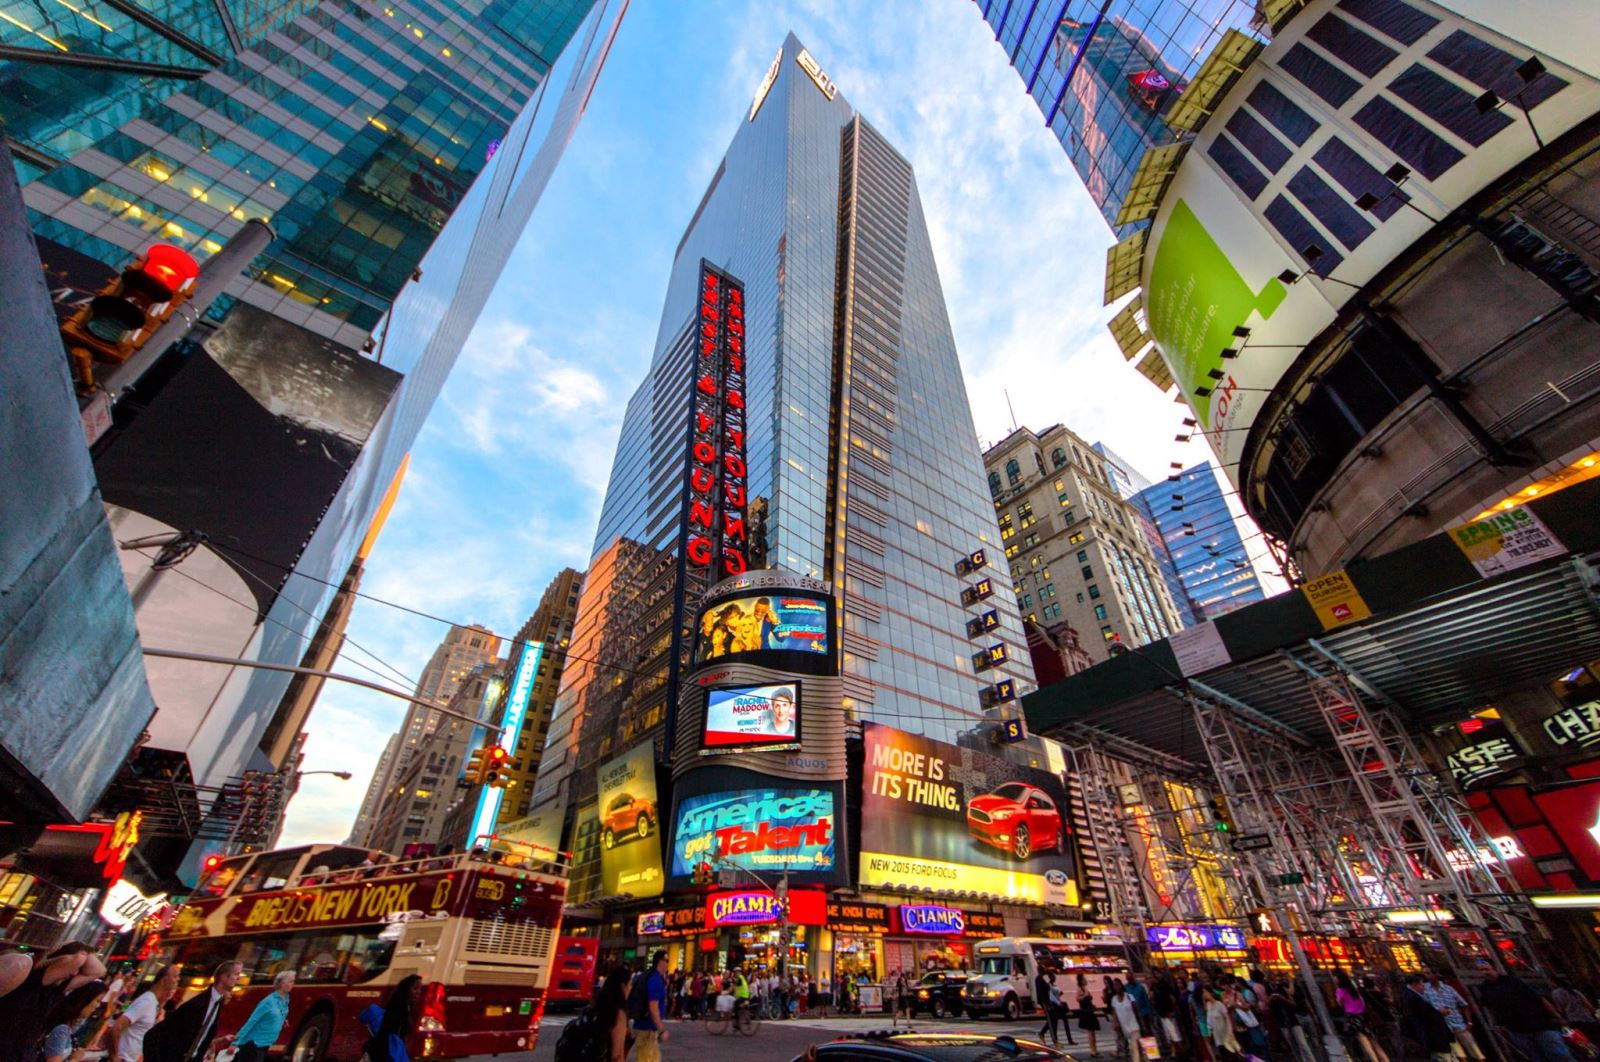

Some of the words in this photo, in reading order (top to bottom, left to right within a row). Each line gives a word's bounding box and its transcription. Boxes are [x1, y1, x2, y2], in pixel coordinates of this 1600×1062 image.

[687, 411, 715, 567] YOUNG
[1456, 508, 1529, 540] SPRING
[1307, 573, 1344, 592] OPEN
[1311, 582, 1349, 600] DURING
[973, 552, 1020, 738] CHAMPS
[732, 703, 770, 715] MADDOW
[736, 696, 769, 706] RACHEL
[787, 757, 827, 769] AQUOS
[872, 743, 926, 779] MORE
[927, 757, 944, 782] IS
[871, 771, 902, 799] ITS
[905, 778, 961, 812] THING.
[675, 789, 834, 841] America's
[684, 831, 713, 860] got
[715, 818, 833, 857] Talent
[870, 858, 891, 872] NEW
[891, 862, 911, 874] 2015
[911, 863, 932, 877] FORD
[933, 867, 957, 880] FOCUS
[306, 888, 360, 922] NEW
[357, 881, 417, 918] YORK
[827, 904, 840, 917] WE
[841, 906, 864, 918] KNOW
[865, 907, 885, 920] GAME
[906, 908, 965, 931] CHAMPS
